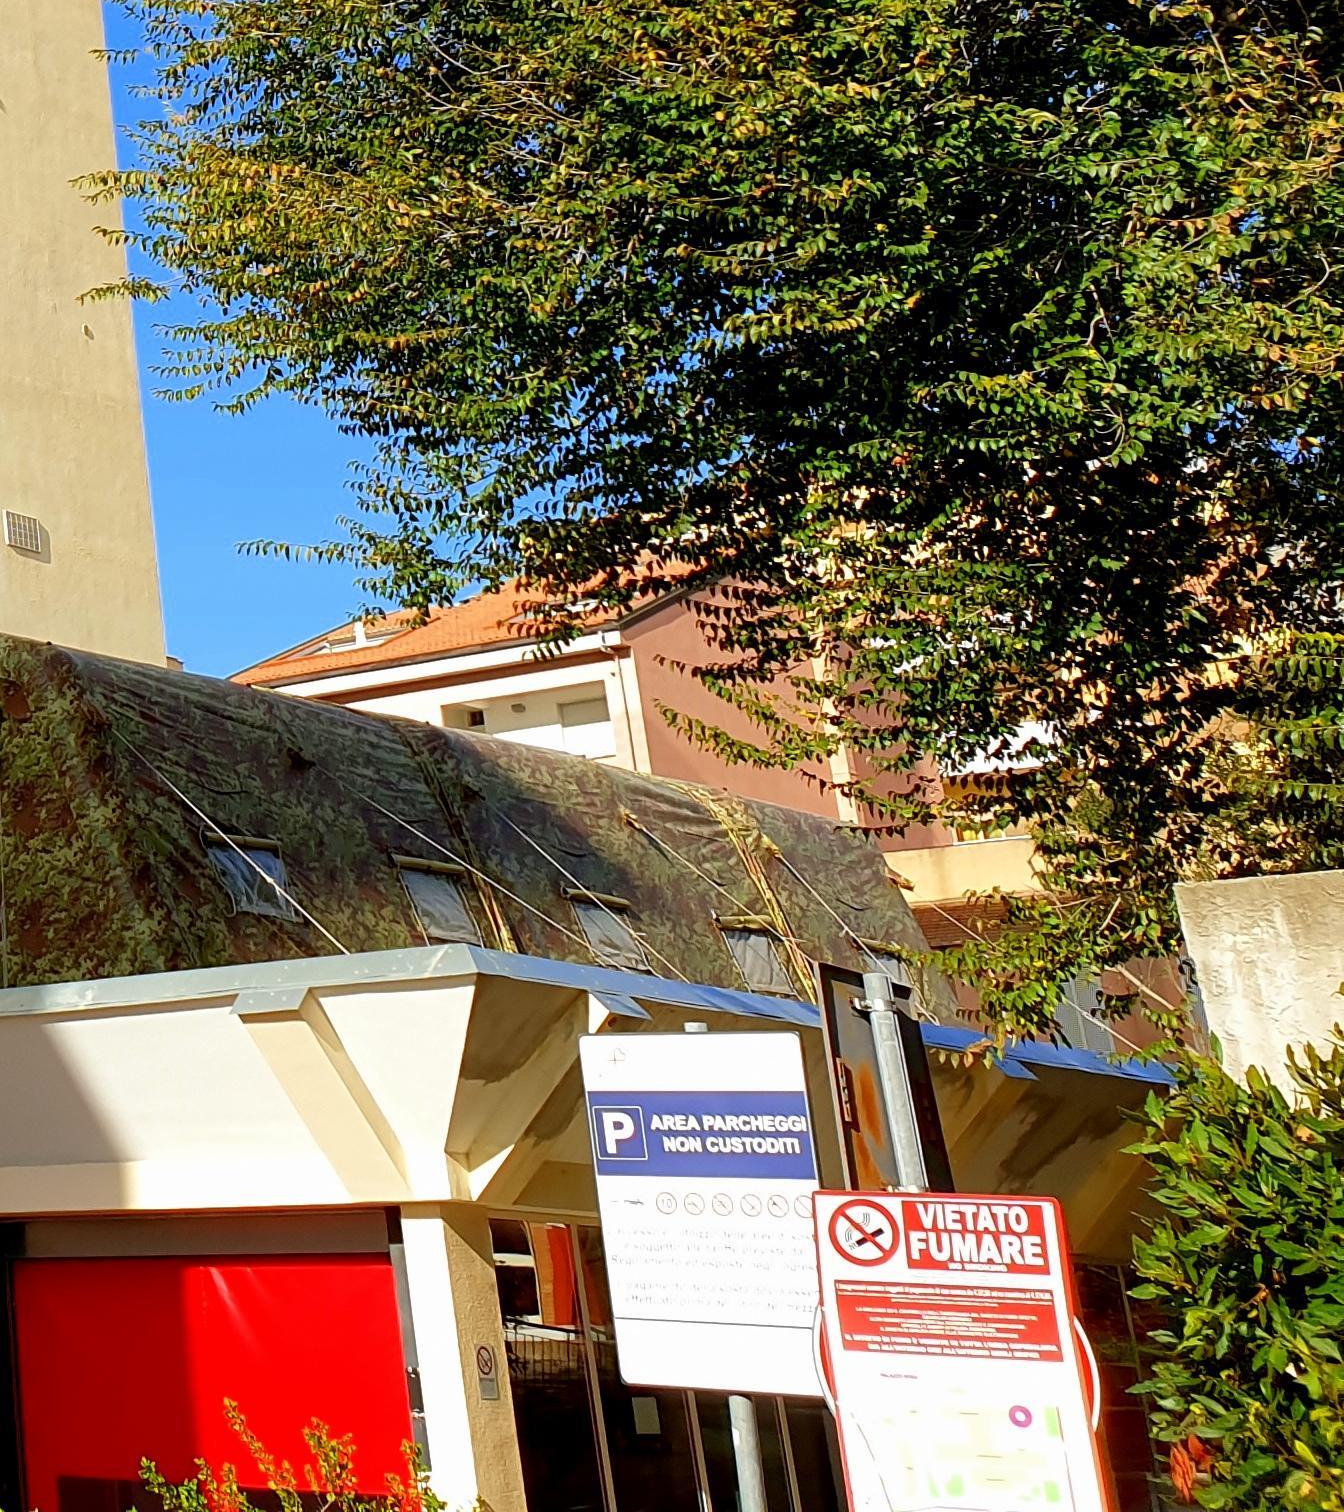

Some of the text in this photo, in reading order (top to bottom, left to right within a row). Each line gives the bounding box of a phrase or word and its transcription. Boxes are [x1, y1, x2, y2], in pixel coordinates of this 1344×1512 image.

[602, 1112, 635, 1154] P
[651, 1114, 808, 1133] AREA PARCHEGGI
[663, 1136, 801, 1154] NON CUSTODITI
[915, 1202, 1029, 1234] VIETATO
[908, 1230, 1045, 1266] FUMARE
